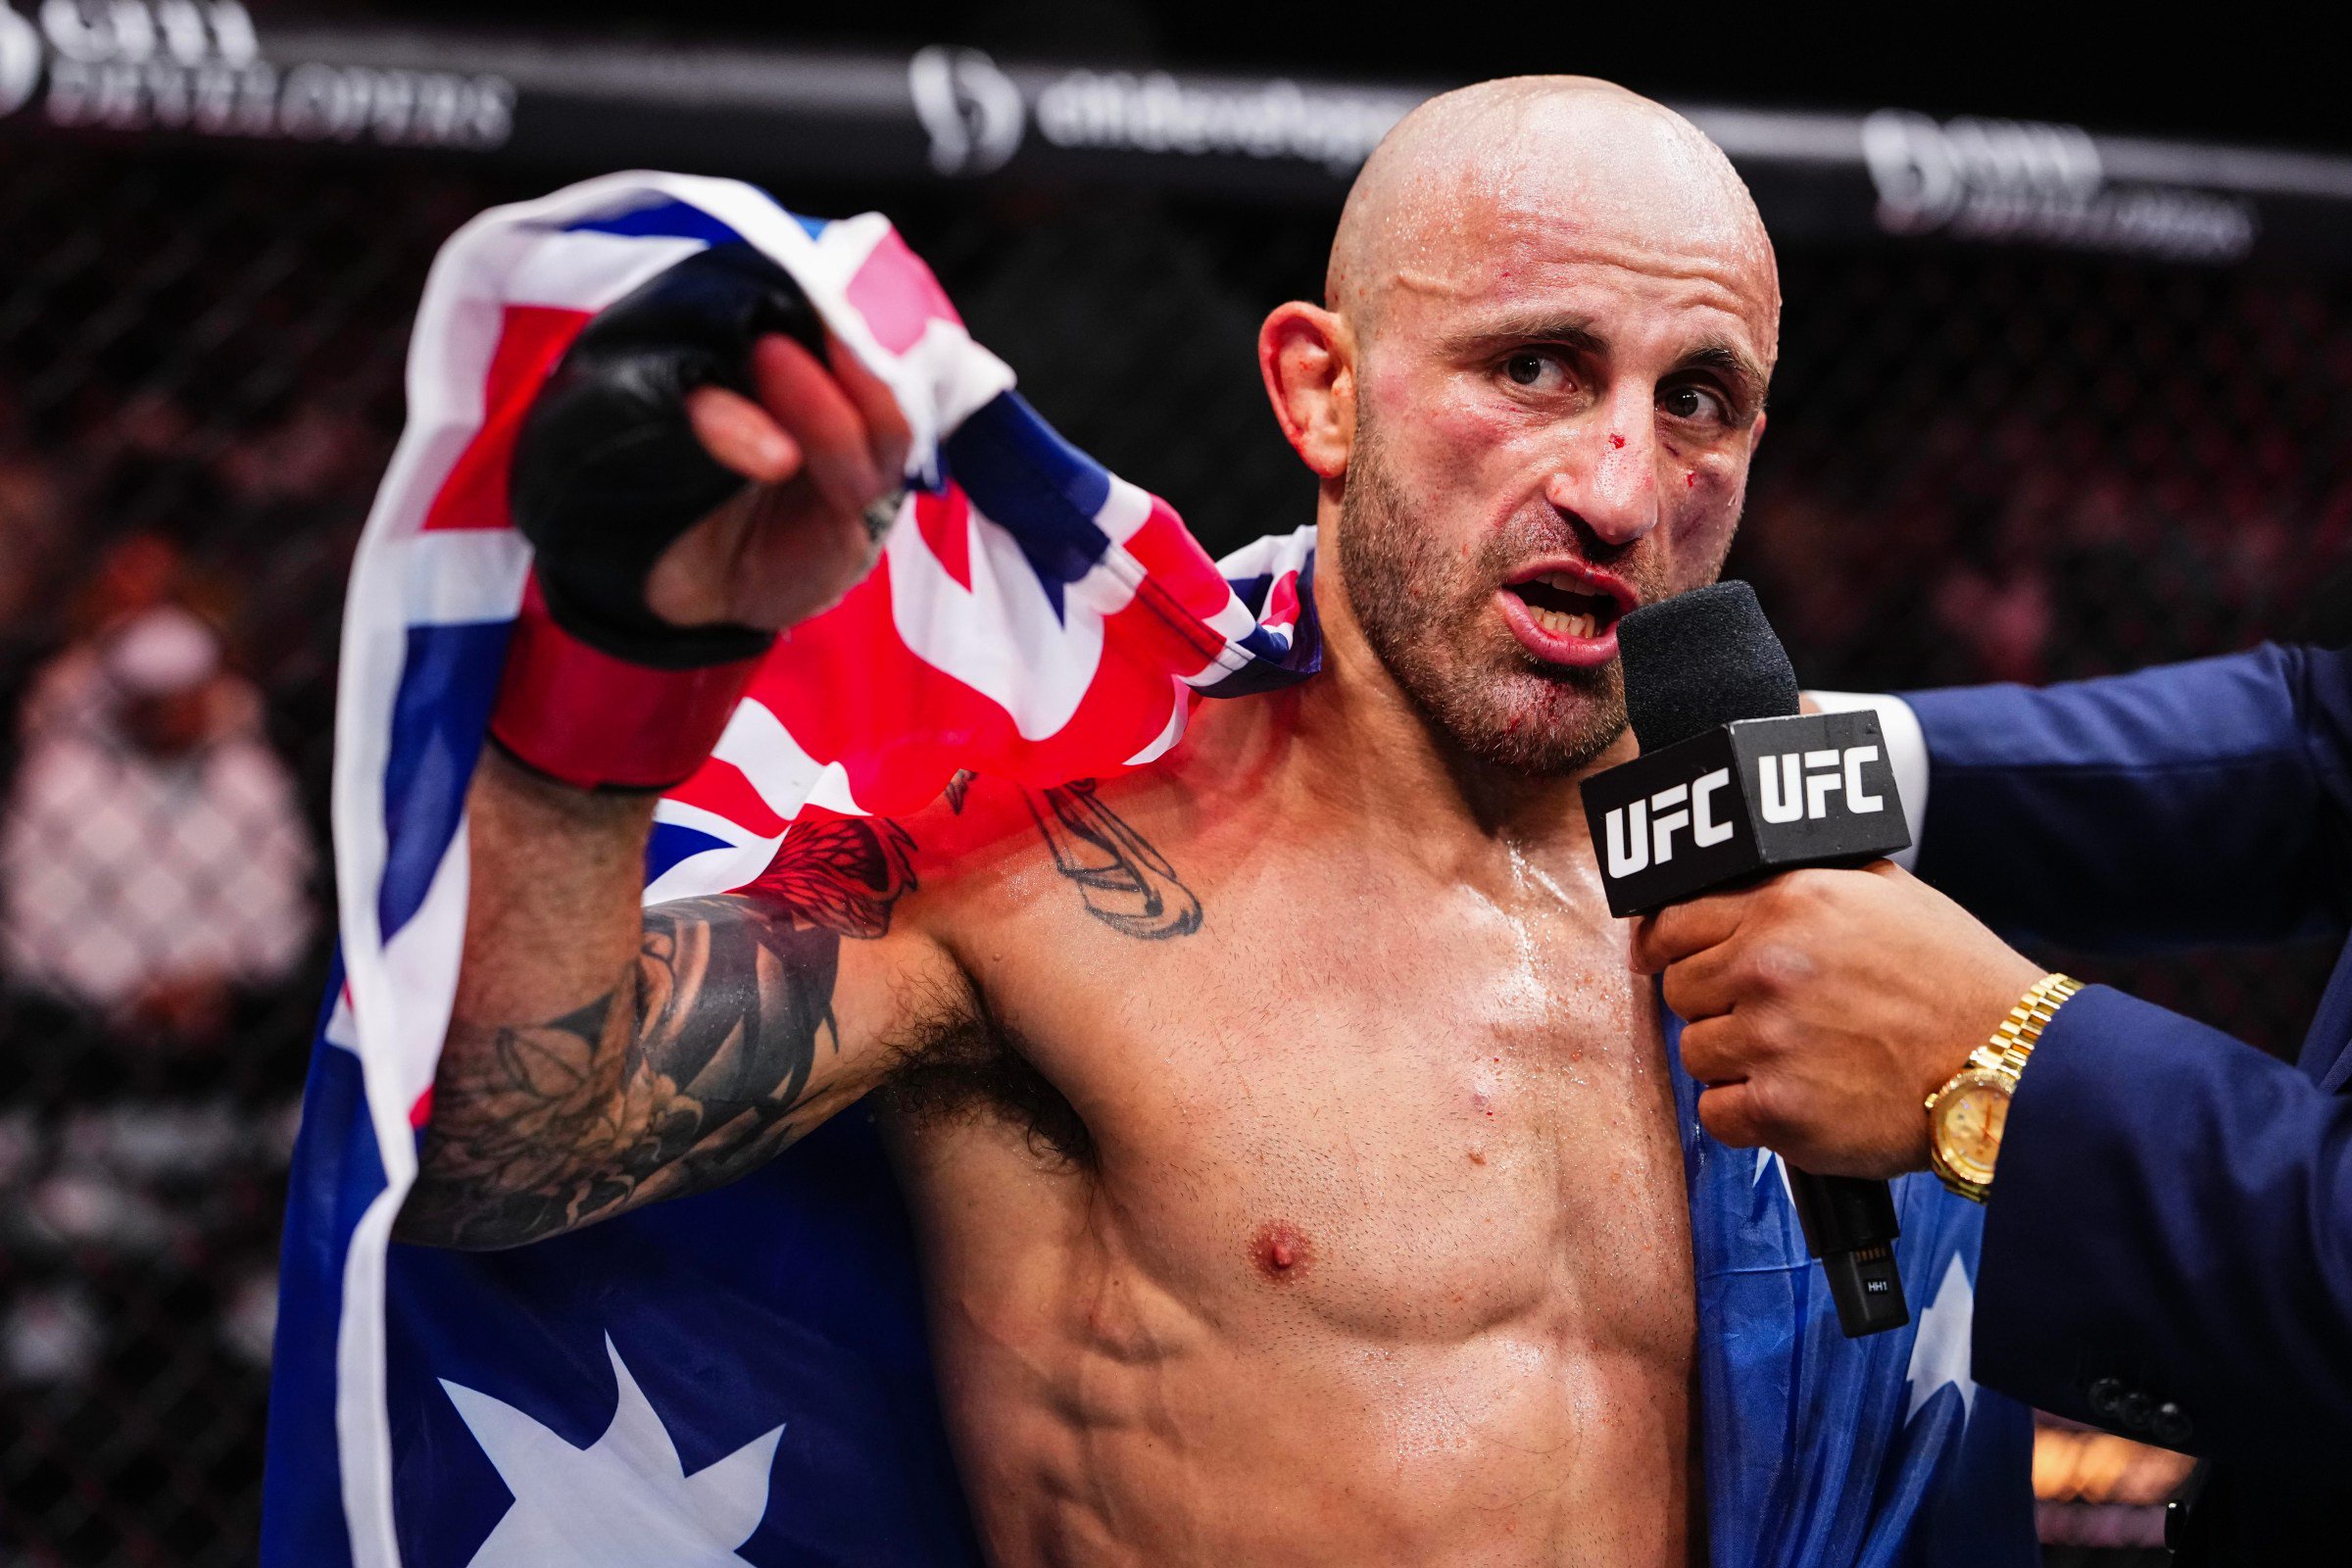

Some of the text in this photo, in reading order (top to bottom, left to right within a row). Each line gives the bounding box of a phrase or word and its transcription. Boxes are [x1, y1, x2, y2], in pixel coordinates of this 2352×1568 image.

[47, 59, 517, 151] DEVELOPERS
[1605, 767, 1734, 879] UFC
[1758, 745, 1884, 824] UFC
[1867, 1281, 1888, 1292] HH1
